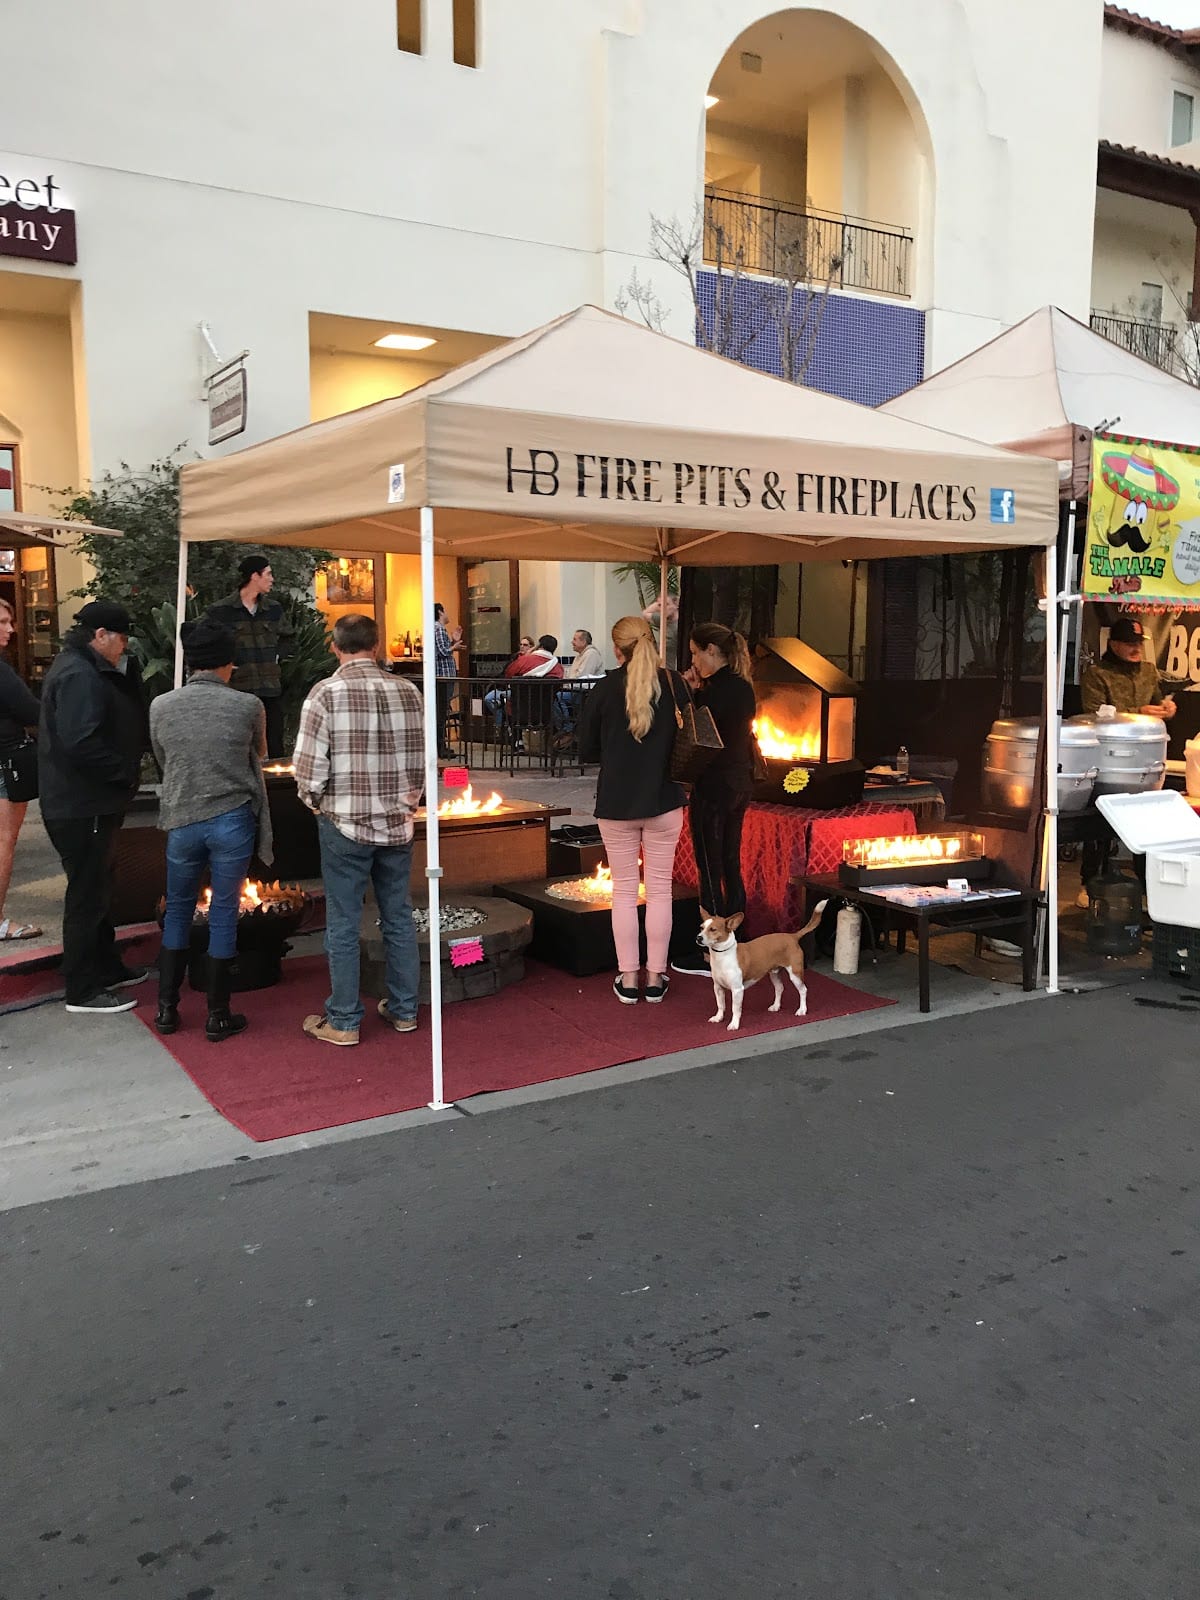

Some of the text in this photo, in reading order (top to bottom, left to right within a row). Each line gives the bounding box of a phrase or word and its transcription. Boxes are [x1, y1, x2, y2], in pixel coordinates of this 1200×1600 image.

[0, 216, 62, 251] any
[574, 453, 663, 503] FIRE
[672, 462, 751, 509] PITS
[761, 471, 787, 512] &
[795, 472, 977, 522] FIREPLACES
[1091, 544, 1110, 558] THE
[1089, 555, 1166, 578] TAMALE
